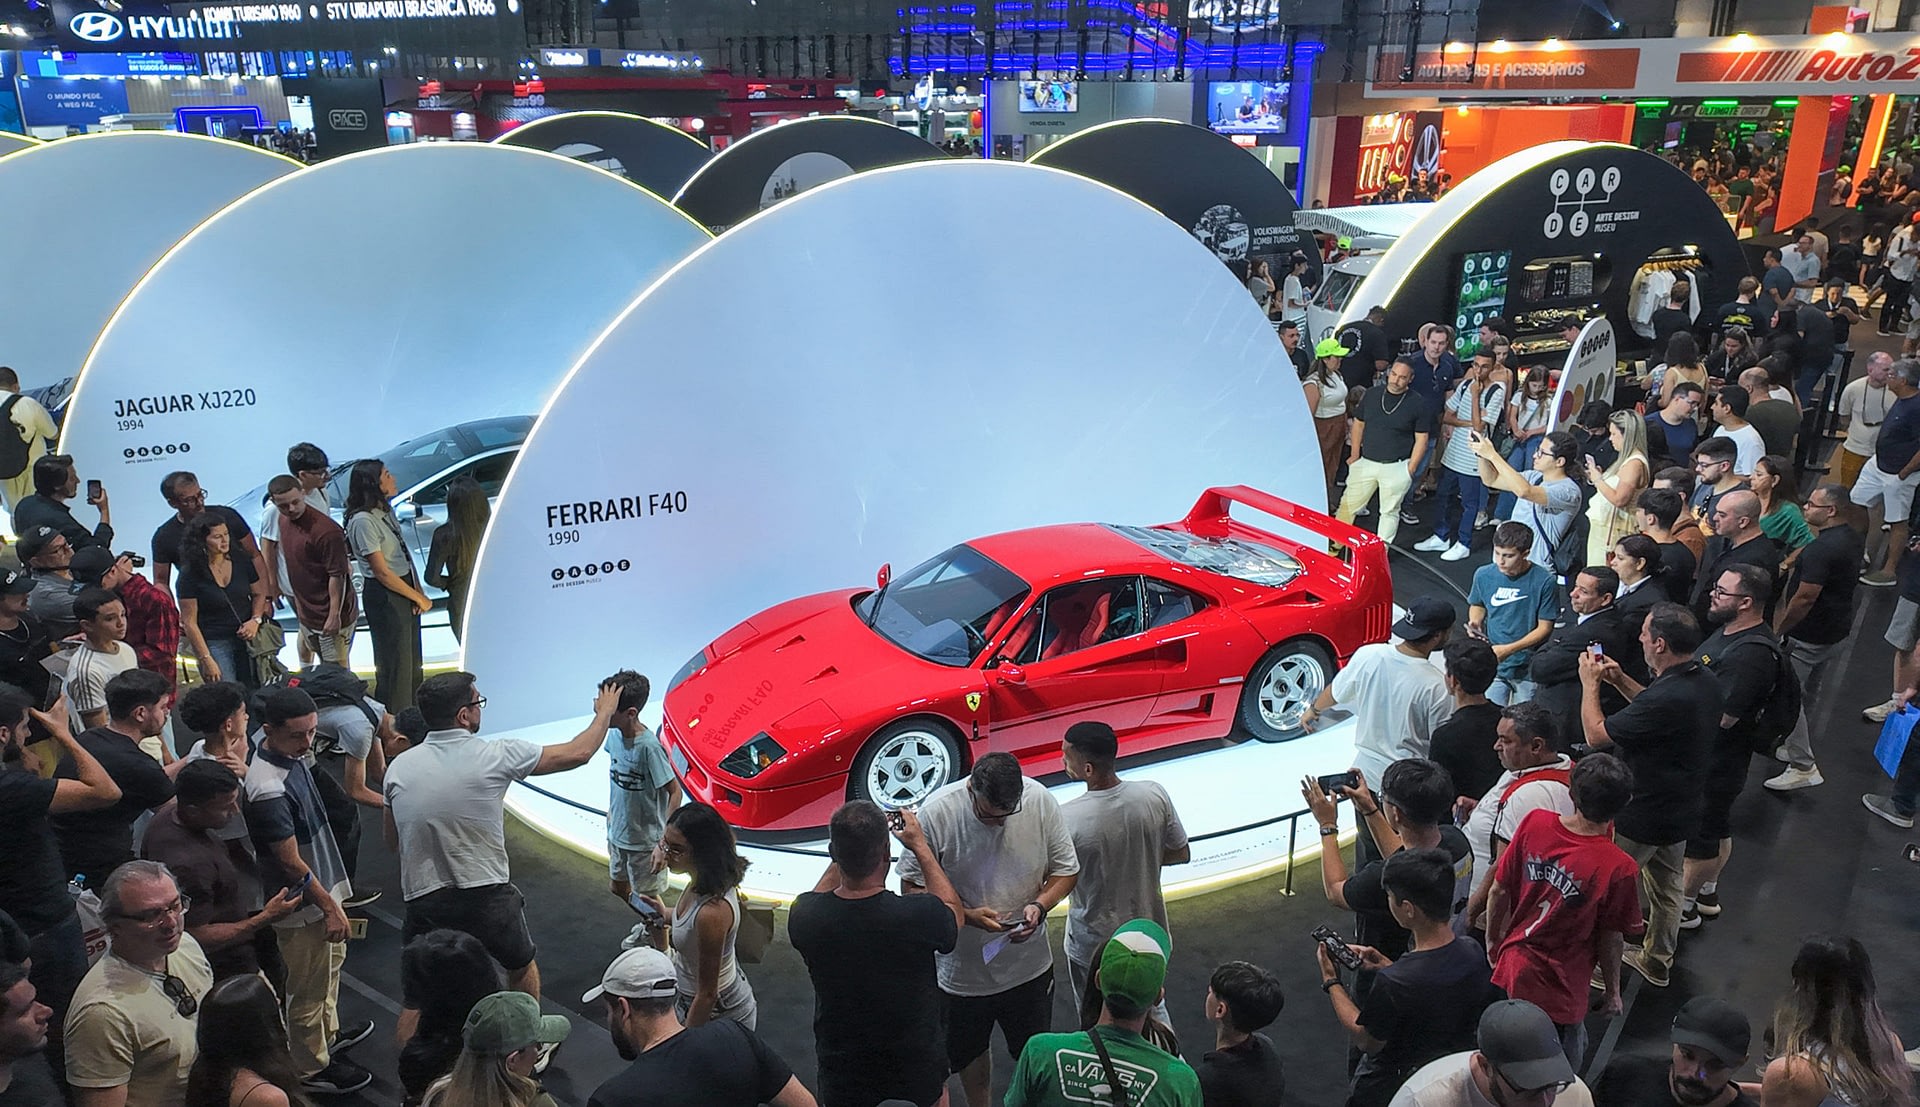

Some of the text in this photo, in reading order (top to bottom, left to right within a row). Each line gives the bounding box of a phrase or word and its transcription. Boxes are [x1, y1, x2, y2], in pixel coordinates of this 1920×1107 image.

[234, 5, 278, 20] TURISMO
[279, 4, 301, 20] 1960
[327, 0, 496, 19] STV UIRAPURU BRASINCA 1966
[127, 16, 241, 39] HYUND
[1493, 63, 1501, 77] E
[1503, 60, 1585, 76] ACESSÓRIOS
[1795, 48, 1920, 81] AutoZ
[332, 112, 364, 126] PACE
[1595, 212, 1613, 222] ARTE
[1253, 226, 1294, 236] VOLKSWAGEN
[114, 388, 257, 418] JAGUAR XJ220
[117, 419, 144, 431] 1994
[546, 490, 687, 528] FERRARI F40
[548, 529, 580, 546] 1990
[1495, 586, 1520, 598] NIKE
[1527, 863, 1580, 900] McGRADY
[1065, 1059, 1146, 1090] CA VAS NY
[1067, 1080, 1087, 1088] SINCE
